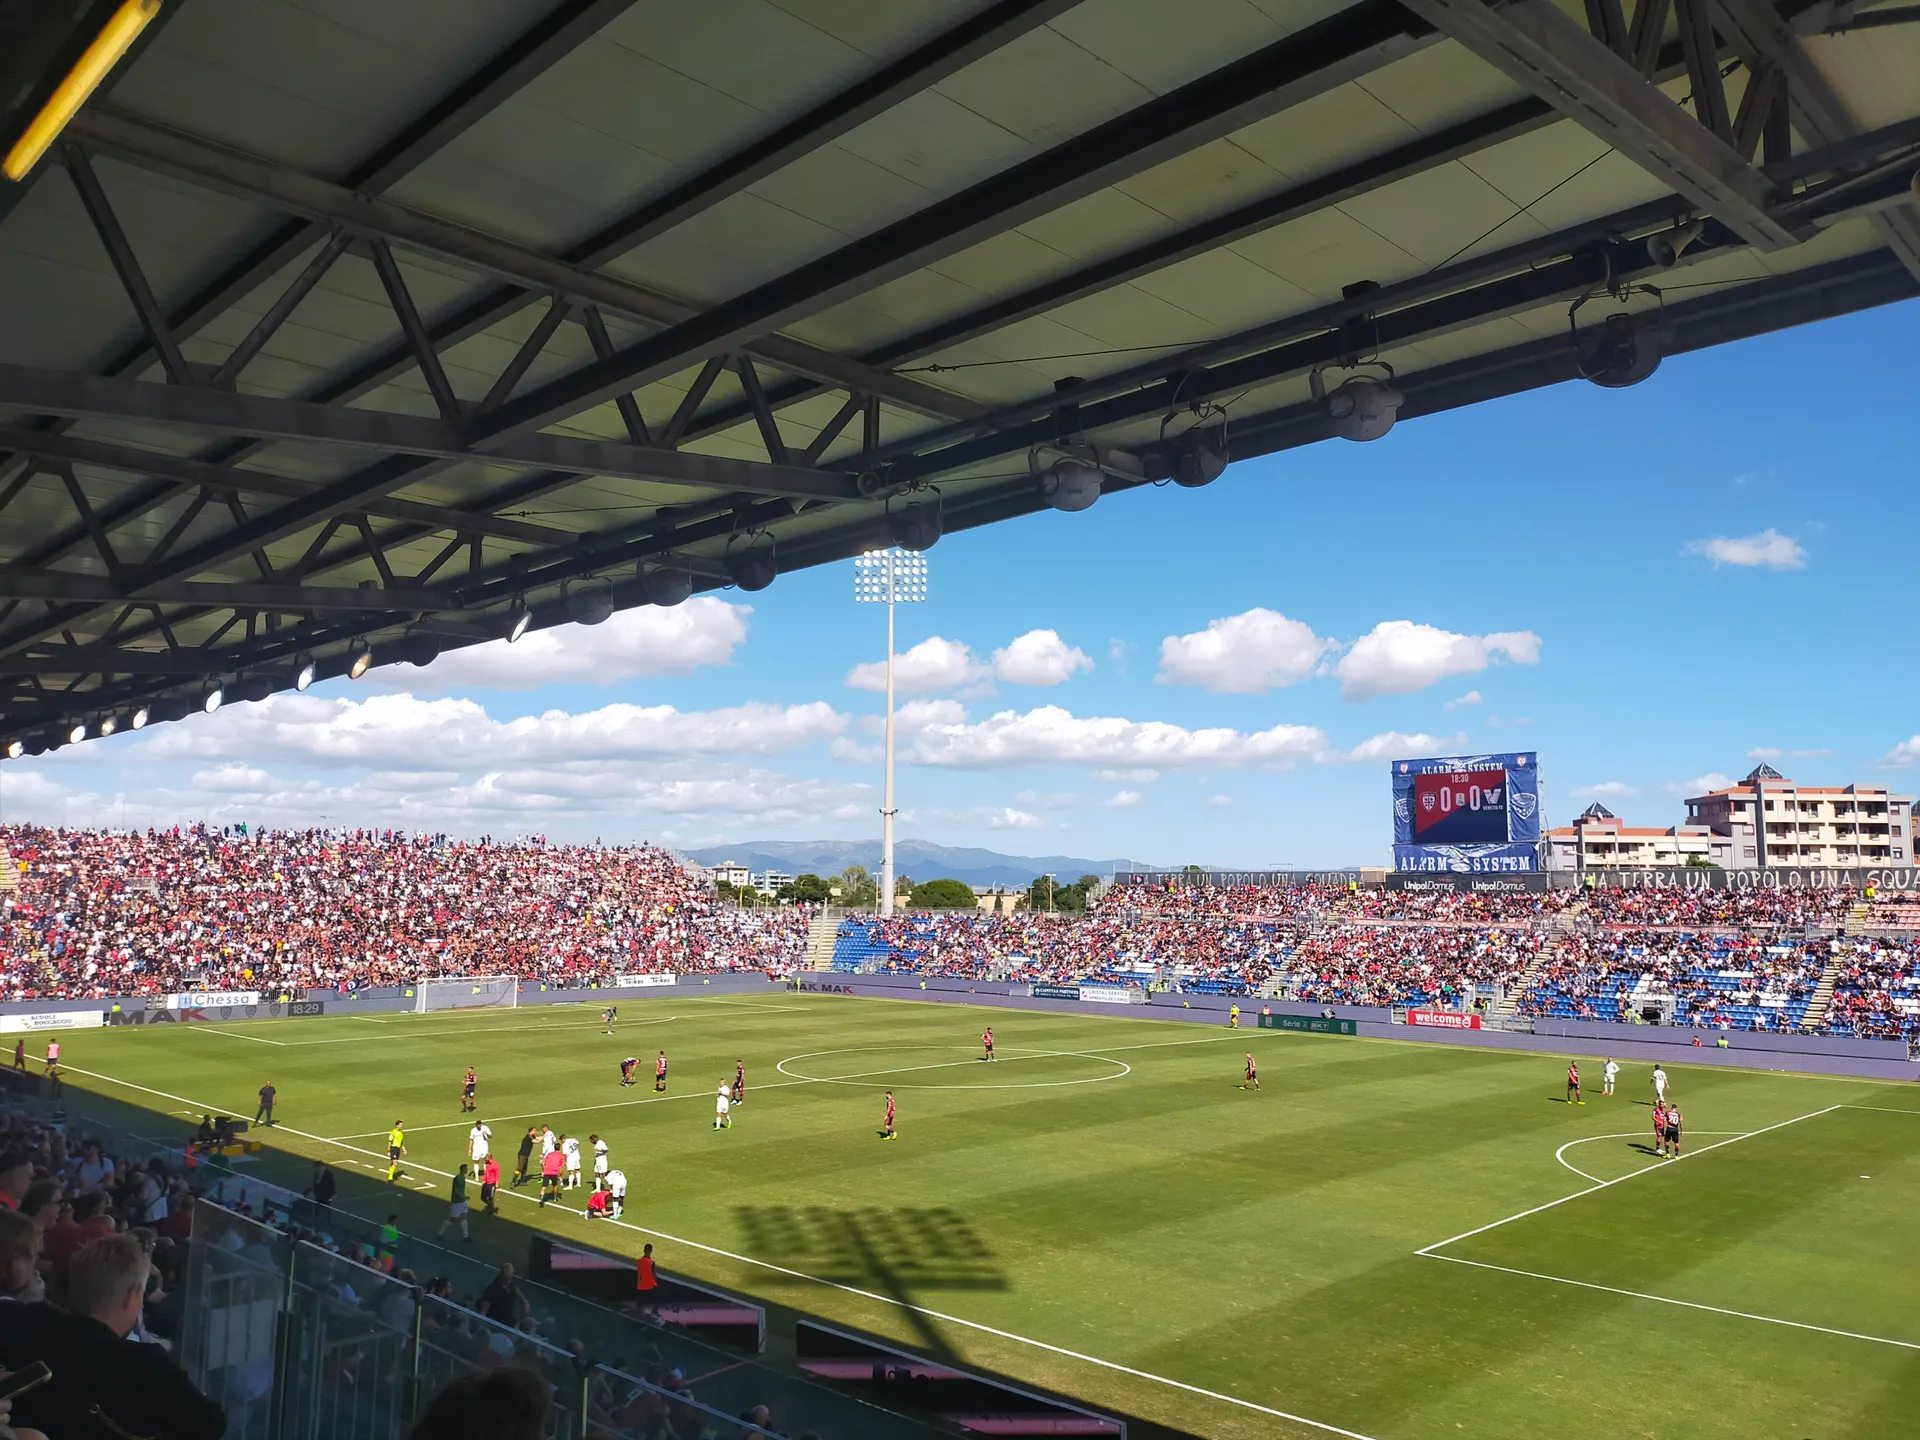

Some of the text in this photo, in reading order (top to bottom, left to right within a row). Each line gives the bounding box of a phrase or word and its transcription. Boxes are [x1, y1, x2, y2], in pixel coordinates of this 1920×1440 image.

[1421, 762, 1503, 775] ALARM SYSTEM
[1451, 774, 1469, 783] 18:30
[1440, 785, 1480, 812] 0 0
[1401, 857, 1530, 871] ALARM SYSTEM
[1197, 873, 1212, 887] UN
[1686, 871, 1711, 890] UN
[1725, 870, 1801, 890] POPOLO
[1810, 869, 1850, 889] UNA
[786, 982, 818, 991] MAK
[822, 984, 854, 994] MAK
[194, 994, 249, 1005] Chessa
[110, 1007, 214, 1025] MAK
[1414, 1012, 1462, 1024] welcome
[1282, 1019, 1301, 1028] Serie
[1668, 1115, 1679, 1125] 20
